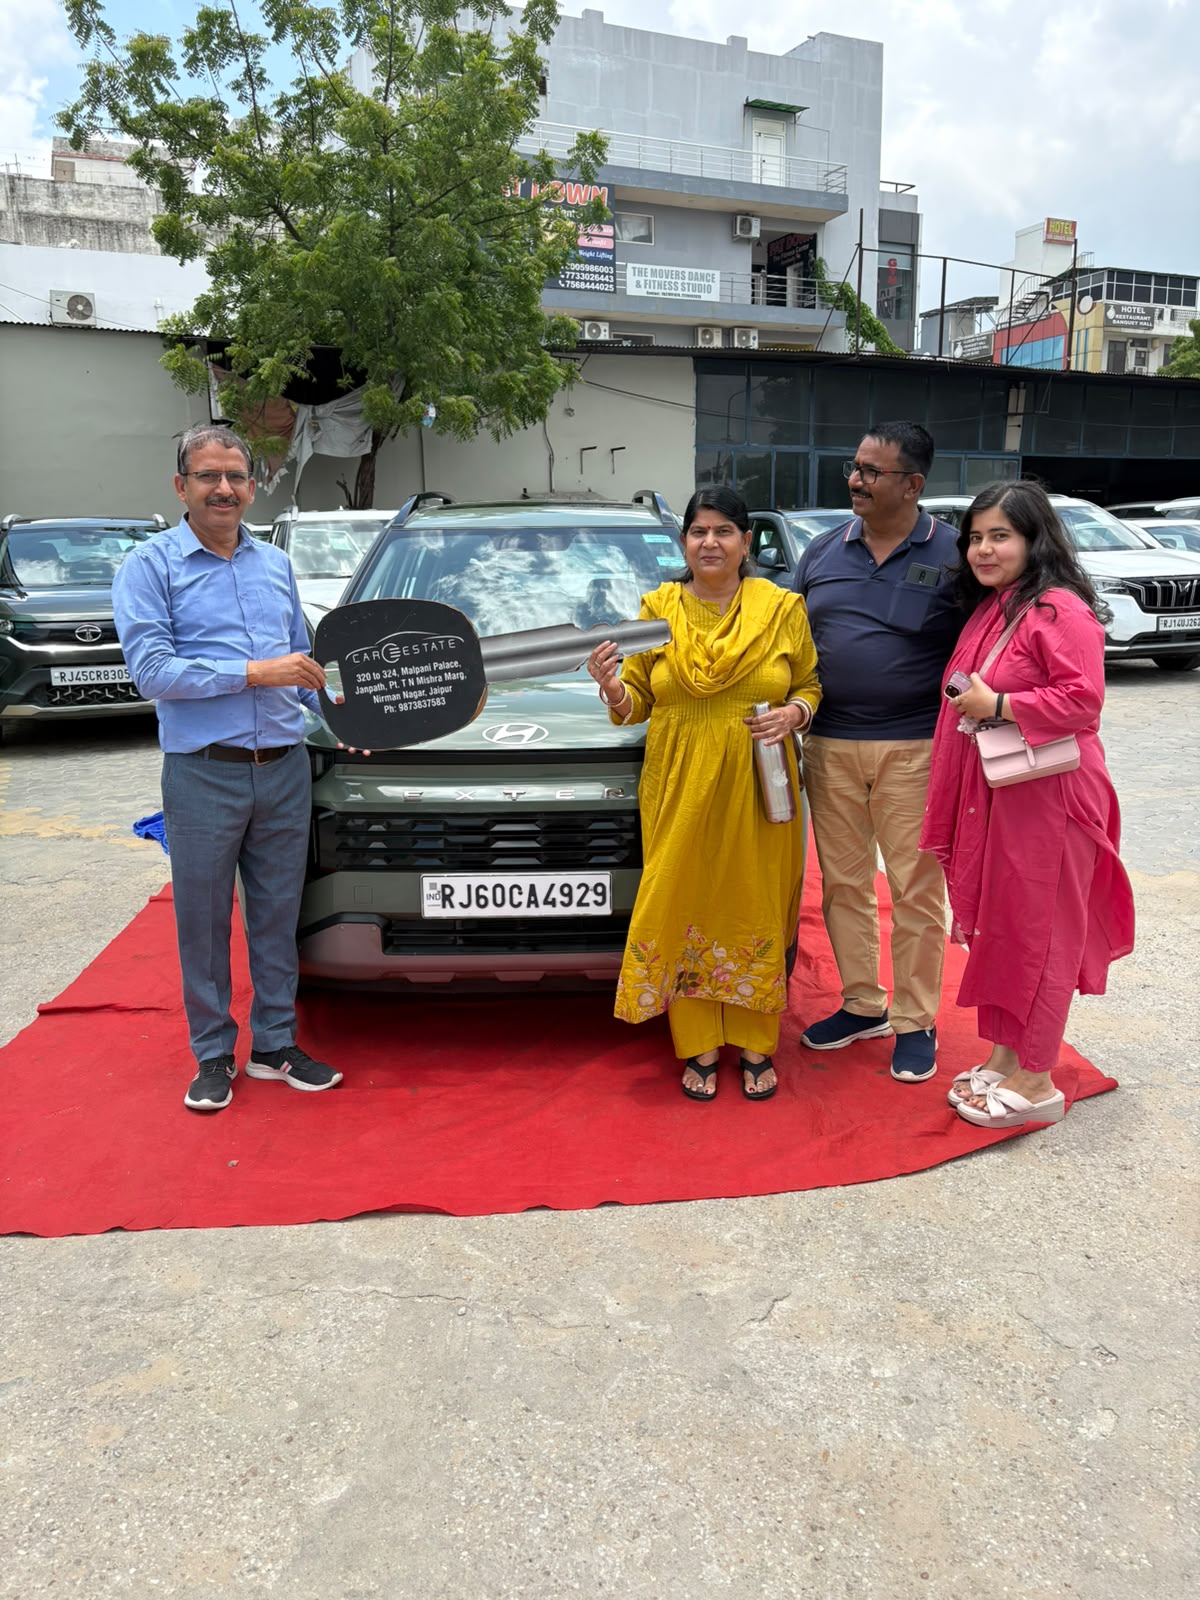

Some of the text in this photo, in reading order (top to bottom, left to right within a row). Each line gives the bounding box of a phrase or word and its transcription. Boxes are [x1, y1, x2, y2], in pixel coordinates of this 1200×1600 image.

[1049, 220, 1073, 235] HOTEL
[565, 272, 614, 283] 7733026443
[632, 266, 716, 283] THE MOVERS DANCE
[565, 280, 614, 292] 7568444025
[635, 279, 712, 294] & FITNESS STUDIO
[1121, 305, 1146, 314] HOTEL
[402, 639, 456, 656] ESTATE
[60, 669, 131, 682] RJ45CR8305
[356, 660, 461, 683] 320 to 324, Malpani Palace,
[355, 671, 467, 695] Janpath, Pt. T N Mishra Marg,
[373, 685, 453, 704] Nirman Nagar, Jaipur
[384, 696, 446, 714] Ph: 9873837583
[402, 787, 625, 801] EXTER
[426, 882, 607, 909] IND RJ60CA4929
